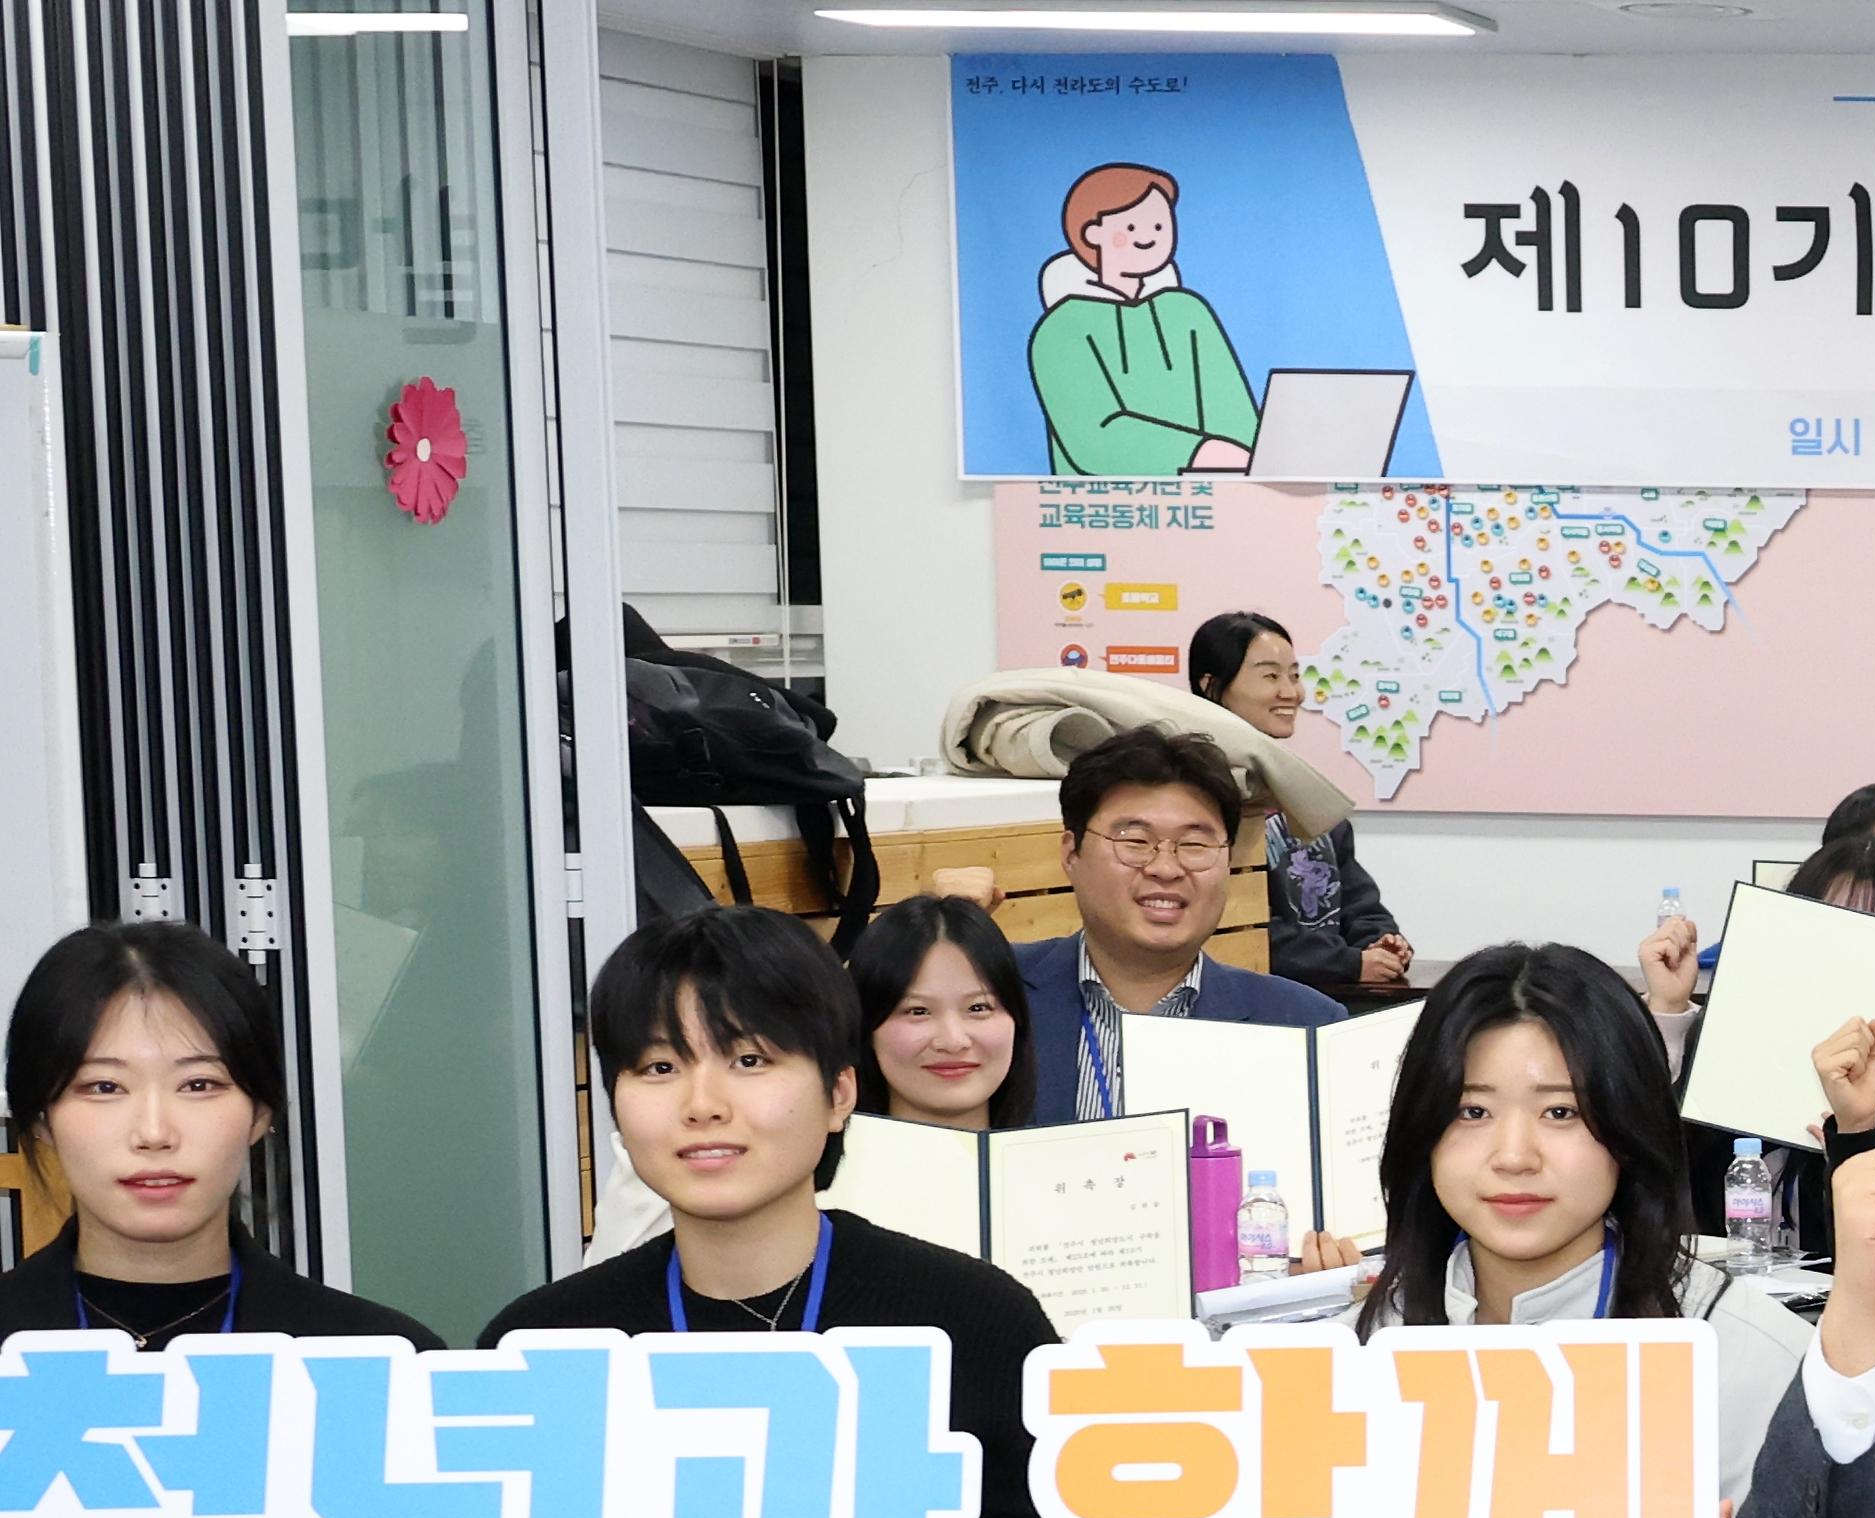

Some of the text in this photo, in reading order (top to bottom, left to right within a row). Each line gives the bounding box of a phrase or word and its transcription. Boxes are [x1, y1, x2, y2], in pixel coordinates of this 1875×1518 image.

[1011, 76, 1045, 94] 다시
[1053, 76, 1120, 95] 전라도의
[1128, 76, 1188, 94] 수도로!
[1460, 180, 1874, 316] 제10기
[1789, 417, 1862, 457] 일시
[1039, 503, 1215, 530] 교육공동체 지도
